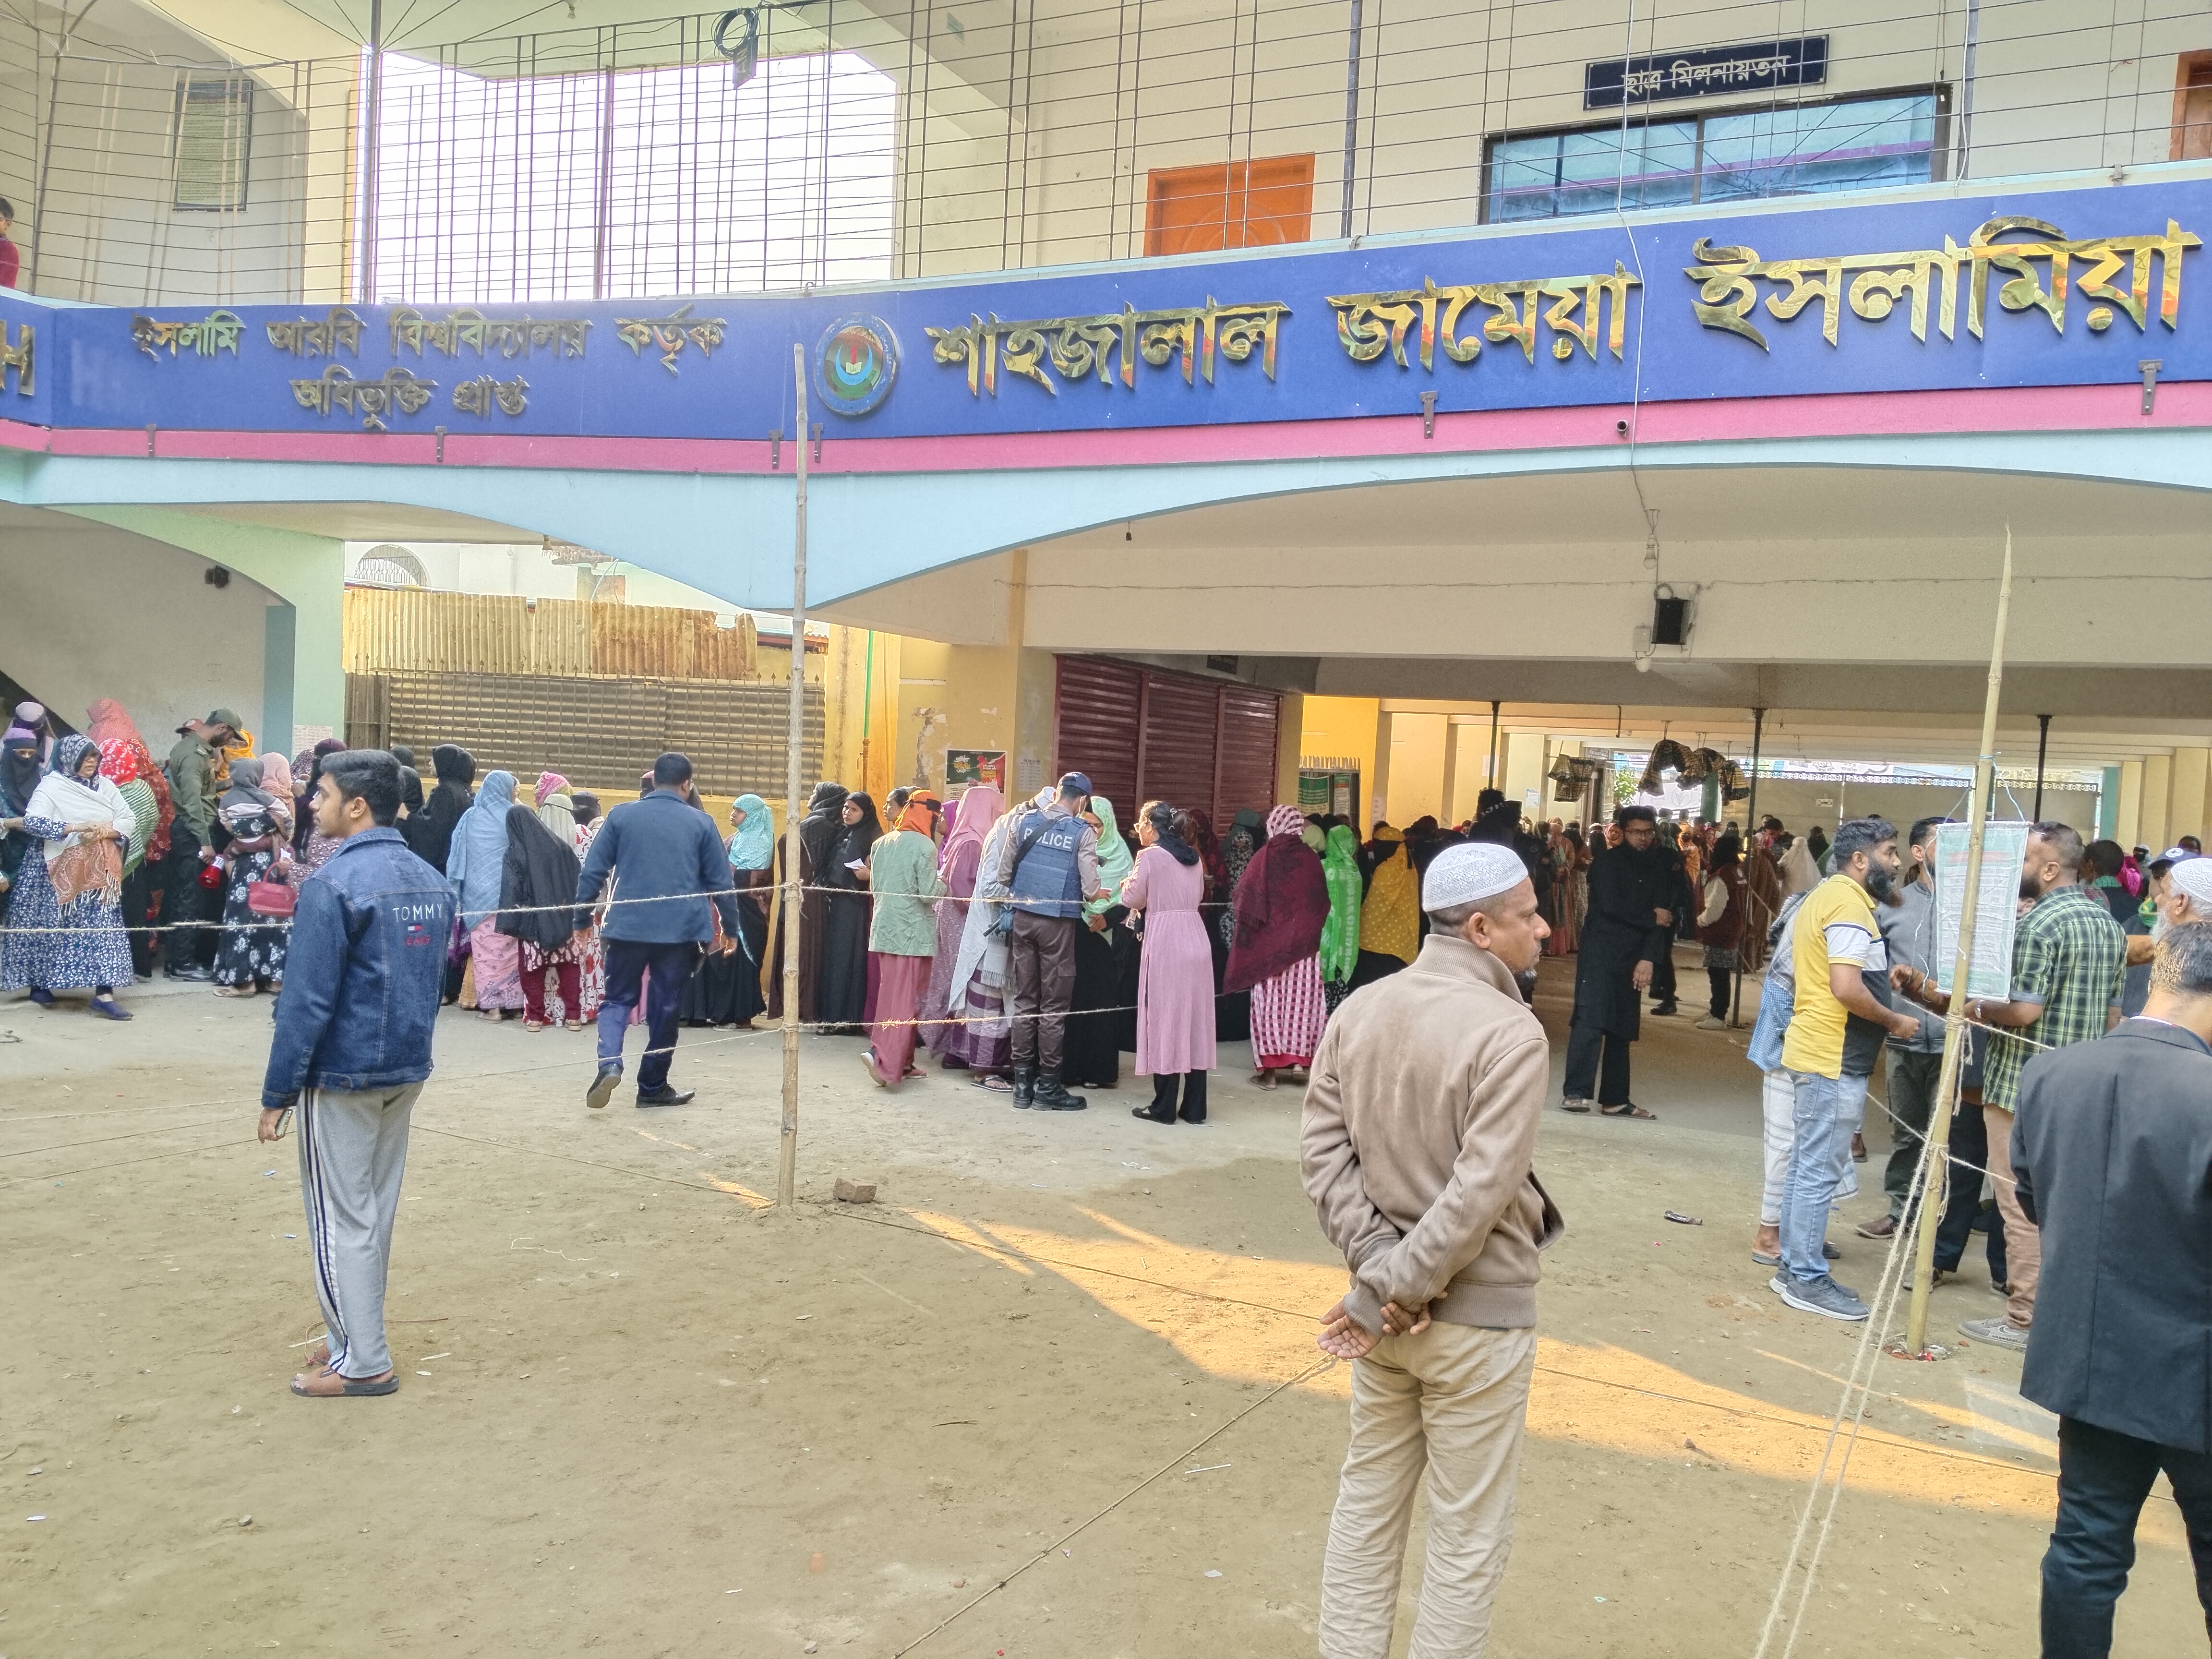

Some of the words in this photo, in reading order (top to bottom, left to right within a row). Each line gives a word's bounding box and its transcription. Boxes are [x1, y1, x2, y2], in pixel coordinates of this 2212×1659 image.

[1622, 69, 1665, 95] ছাত্র
[1670, 55, 1791, 89] মিলনায়তন
[924, 294, 1293, 397] শাহজালাল
[1325, 259, 1643, 372] জামেয়া
[1682, 216, 2202, 353] ইসলামিয়া
[131, 309, 248, 361] ইসলামি
[265, 307, 367, 357] আরবি
[388, 307, 594, 358] বিশ্ববিদ্যালয়
[613, 303, 728, 377] কর্তৃক
[289, 364, 438, 431] অধিভুক্তি
[452, 374, 530, 417] প্রাপ্ত
[1023, 827, 1073, 849] PLICE
[393, 903, 442, 923] TOMMY
